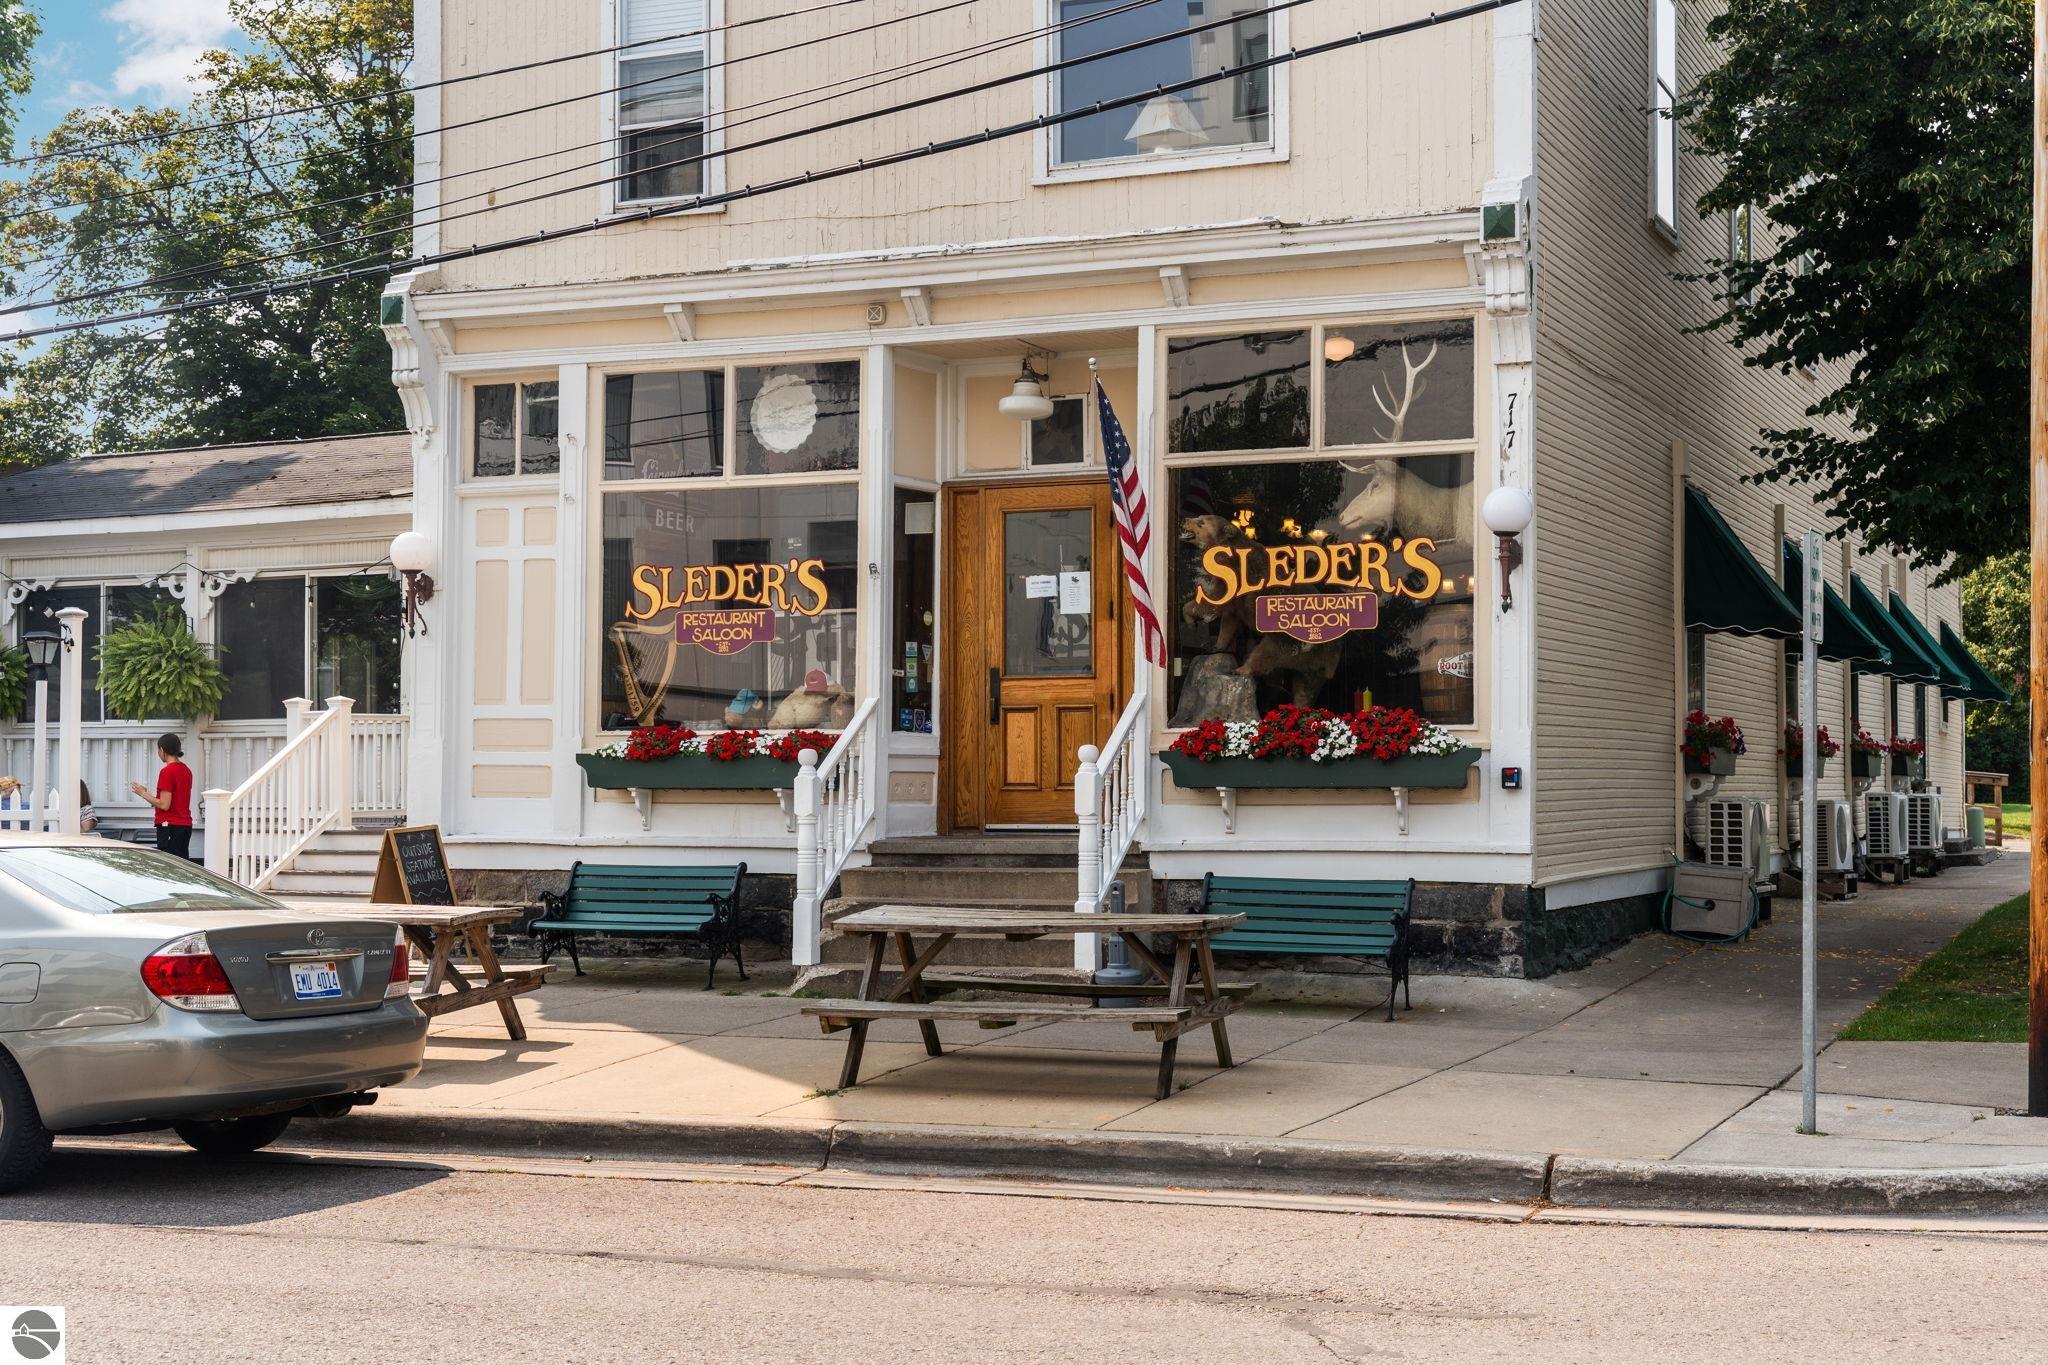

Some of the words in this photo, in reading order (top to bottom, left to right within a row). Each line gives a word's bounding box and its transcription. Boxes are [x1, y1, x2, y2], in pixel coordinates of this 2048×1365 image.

[1506, 392, 1518, 449] 717
[655, 508, 694, 533] BEER
[1195, 537, 1442, 606] SLEDER'S
[624, 558, 829, 621] SLEDER'S
[1267, 595, 1366, 616] RESTAURANT
[683, 611, 766, 630] RESTAURANT
[1278, 613, 1350, 630] SALOON
[691, 627, 753, 642] SALOON
[1439, 662, 1463, 670] ROOT
[402, 843, 434, 858] OUTSIDE
[405, 856, 436, 873] SEATING
[406, 868, 446, 886] AVAILABLE
[295, 973, 313, 991] EMU
[317, 972, 338, 990] 4014
